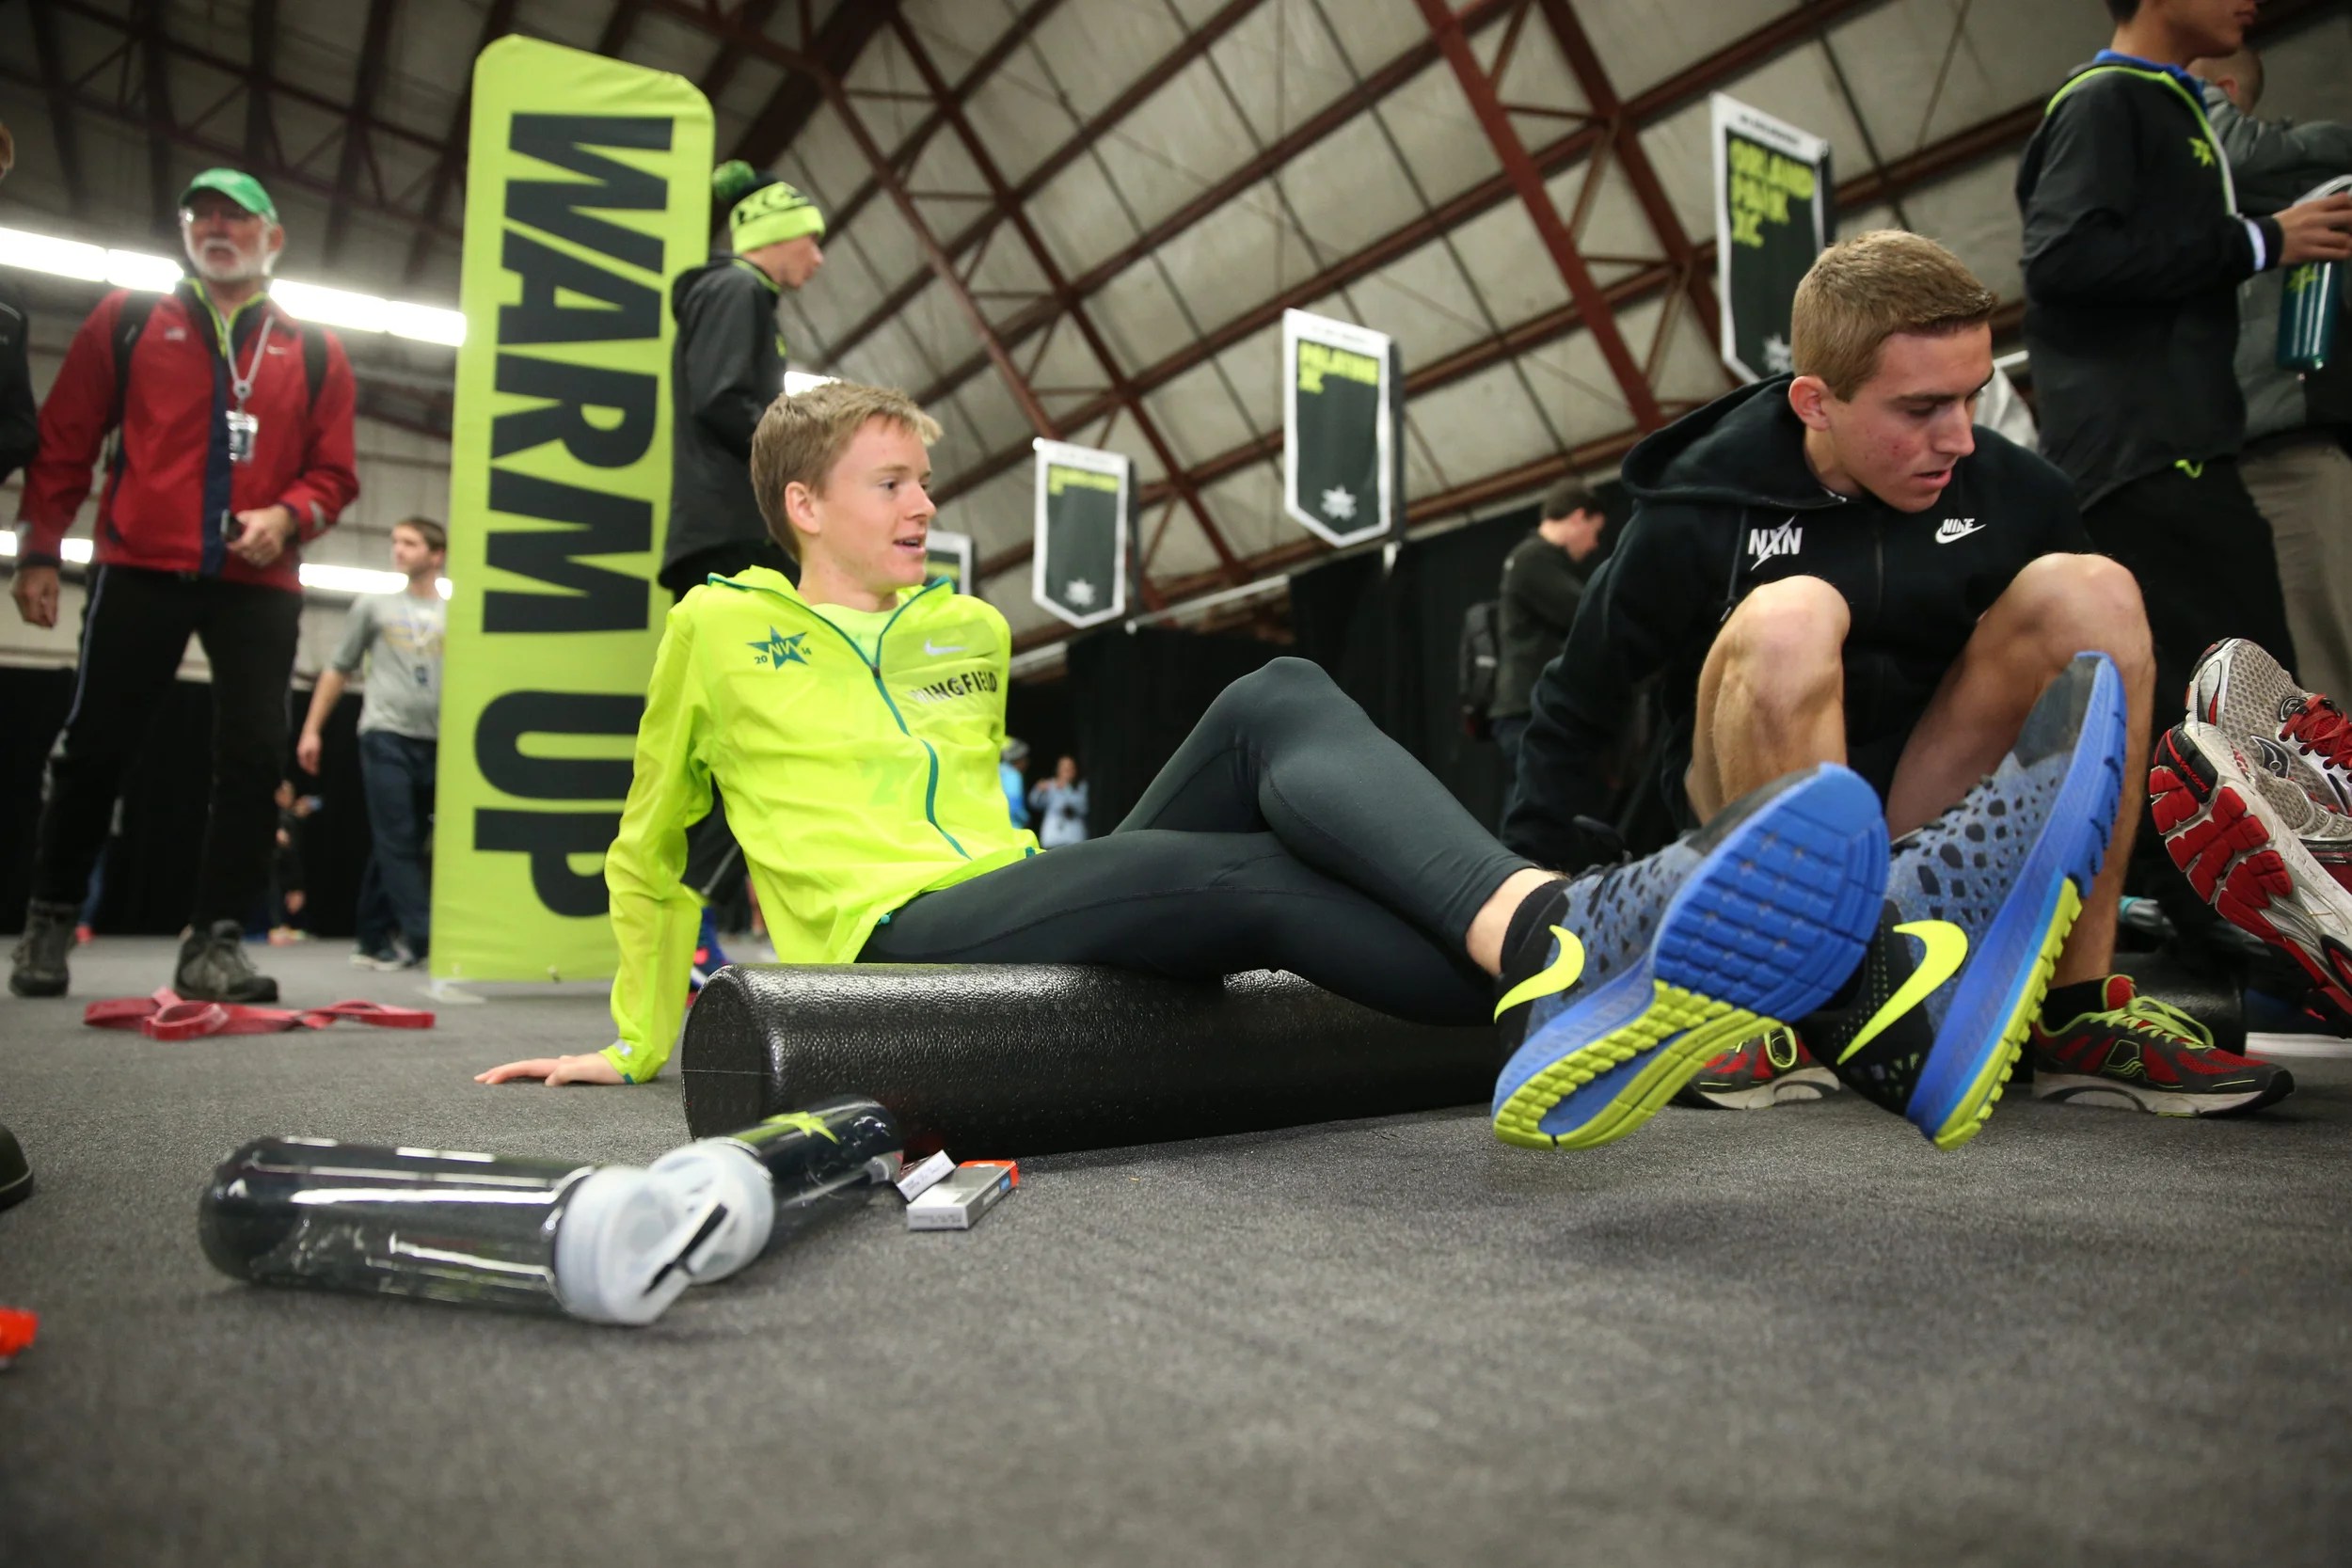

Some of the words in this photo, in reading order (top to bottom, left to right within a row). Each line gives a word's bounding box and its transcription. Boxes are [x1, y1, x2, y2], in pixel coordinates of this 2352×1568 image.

[482, 112, 675, 633] WARM
[1942, 517, 1976, 533] NIKE
[1747, 527, 1804, 556] NXN
[754, 655, 769, 665] 20
[473, 689, 647, 918] UP
